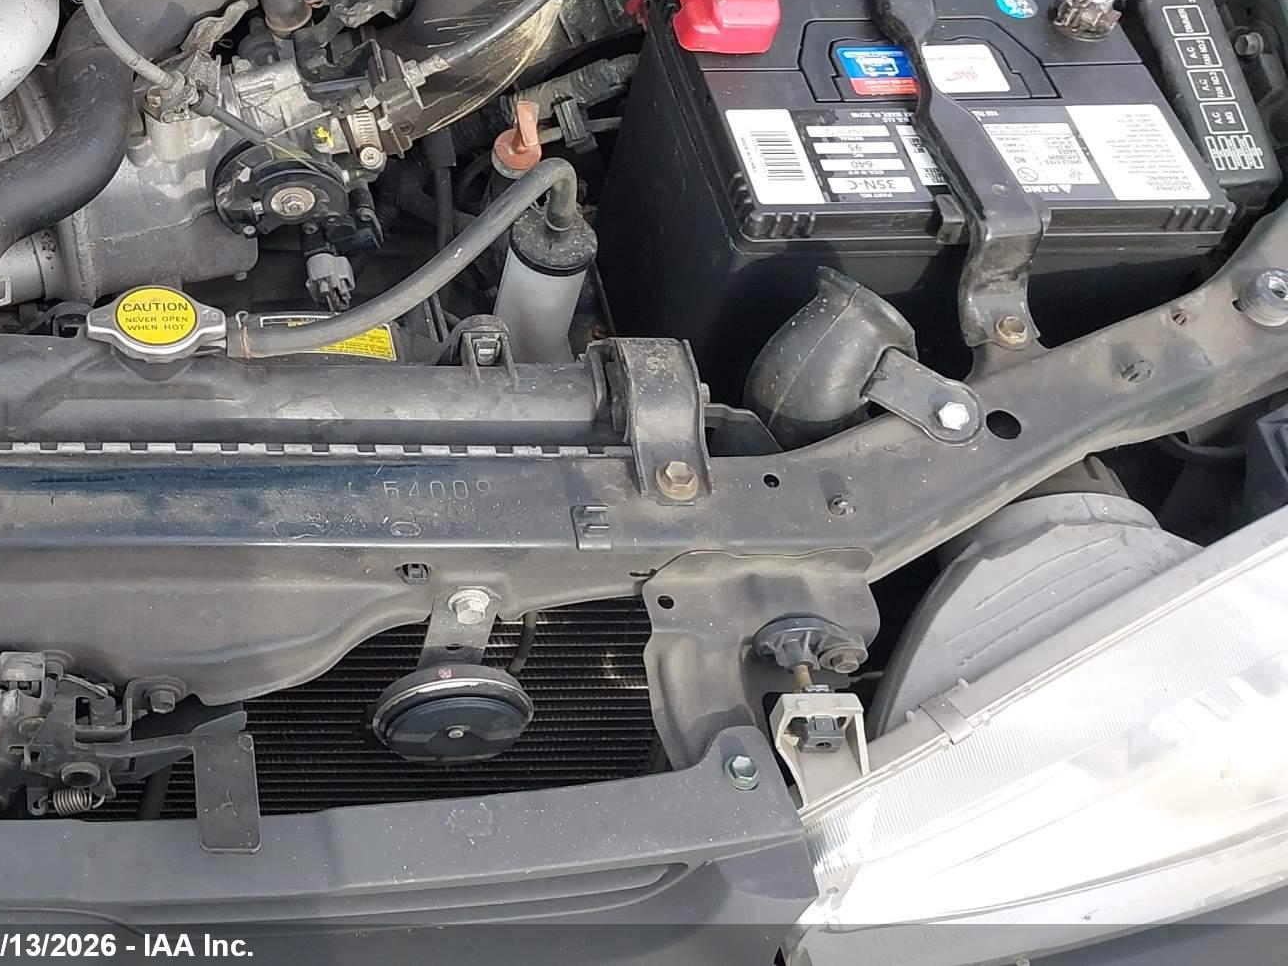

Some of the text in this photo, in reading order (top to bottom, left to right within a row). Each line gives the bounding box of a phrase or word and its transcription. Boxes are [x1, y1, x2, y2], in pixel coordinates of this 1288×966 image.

[1177, 7, 1194, 33] DIMMER
[1201, 54, 1213, 65] FAN
[1214, 86, 1225, 98] FAN
[848, 144, 863, 152] 95
[850, 160, 873, 169] 640
[846, 179, 897, 191] 35N-C
[122, 302, 188, 313] CAUTION
